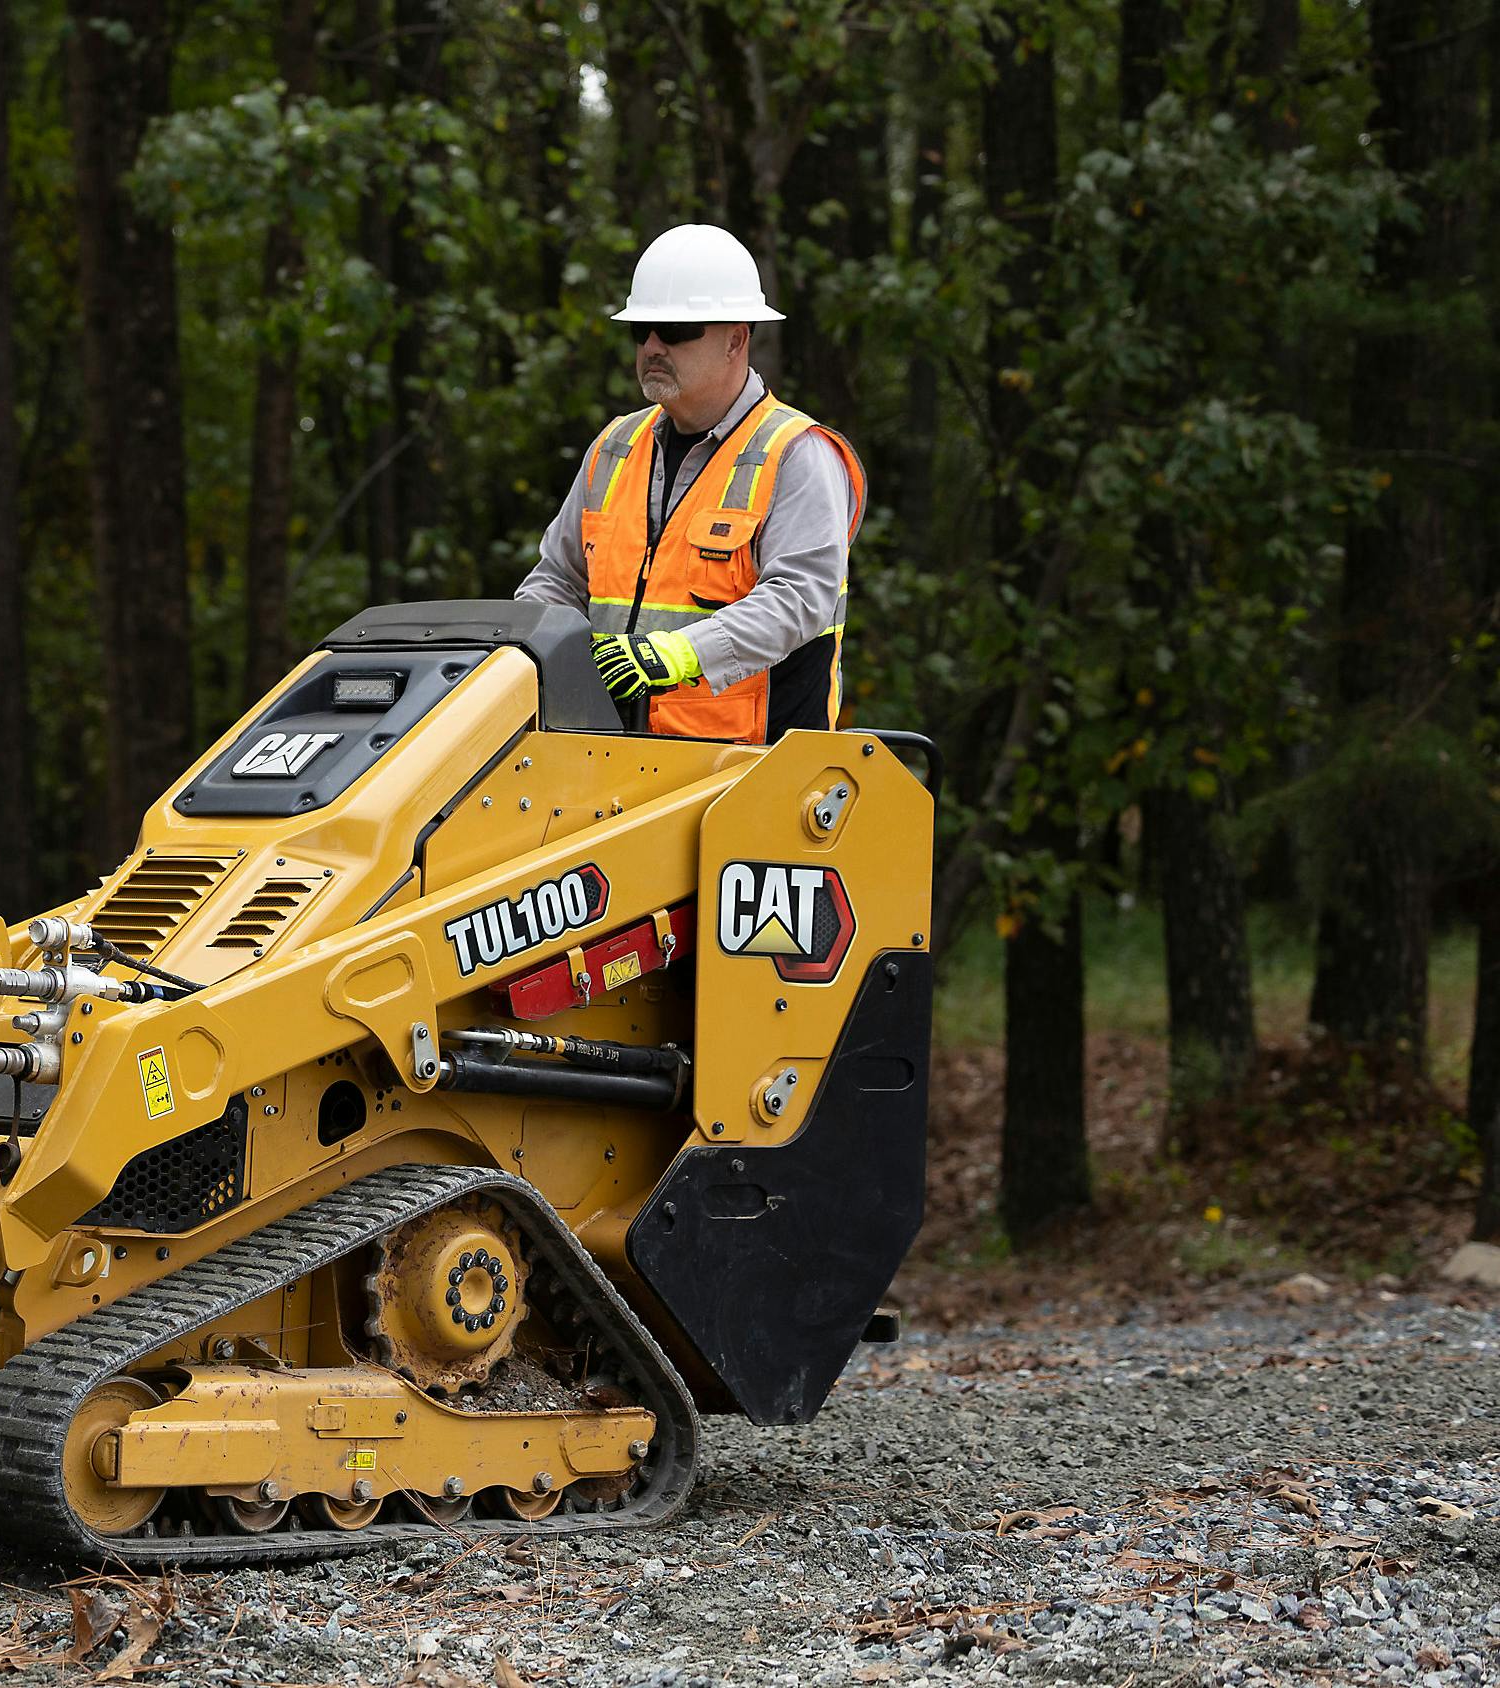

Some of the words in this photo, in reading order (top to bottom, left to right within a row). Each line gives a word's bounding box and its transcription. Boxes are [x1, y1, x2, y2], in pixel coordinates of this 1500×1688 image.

[232, 732, 340, 775] CAT
[446, 872, 589, 973] TUL100
[720, 863, 824, 955] CAT
